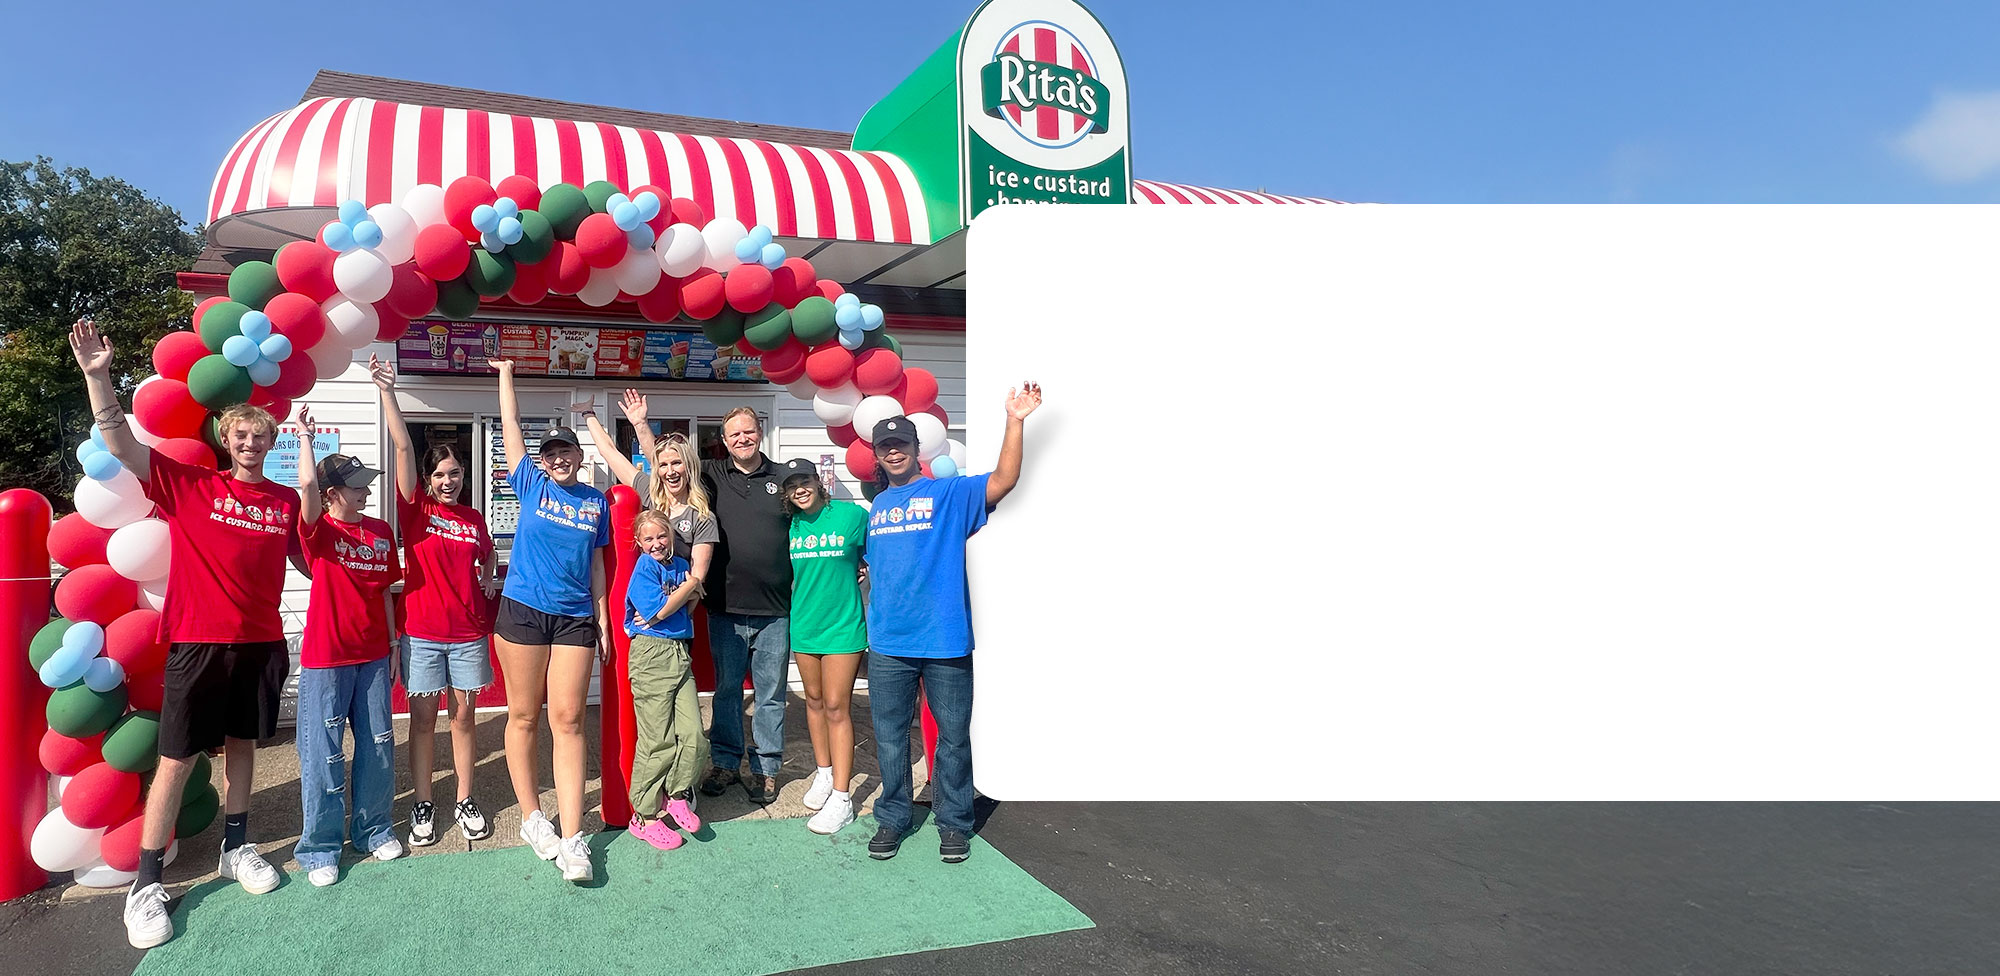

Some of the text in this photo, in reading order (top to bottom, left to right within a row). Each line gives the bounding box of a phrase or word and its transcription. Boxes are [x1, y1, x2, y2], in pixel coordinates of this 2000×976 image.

[999, 55, 1098, 115] Rita's
[989, 165, 1019, 188] ice
[1033, 174, 1111, 198] custard
[287, 440, 296, 449] OF
[210, 512, 225, 522] ICE.
[225, 517, 264, 532] CUSTARD.
[546, 513, 577, 528] CUSTARD.
[876, 526, 905, 535] CUSTARD.
[905, 522, 933, 532] REPEAT.
